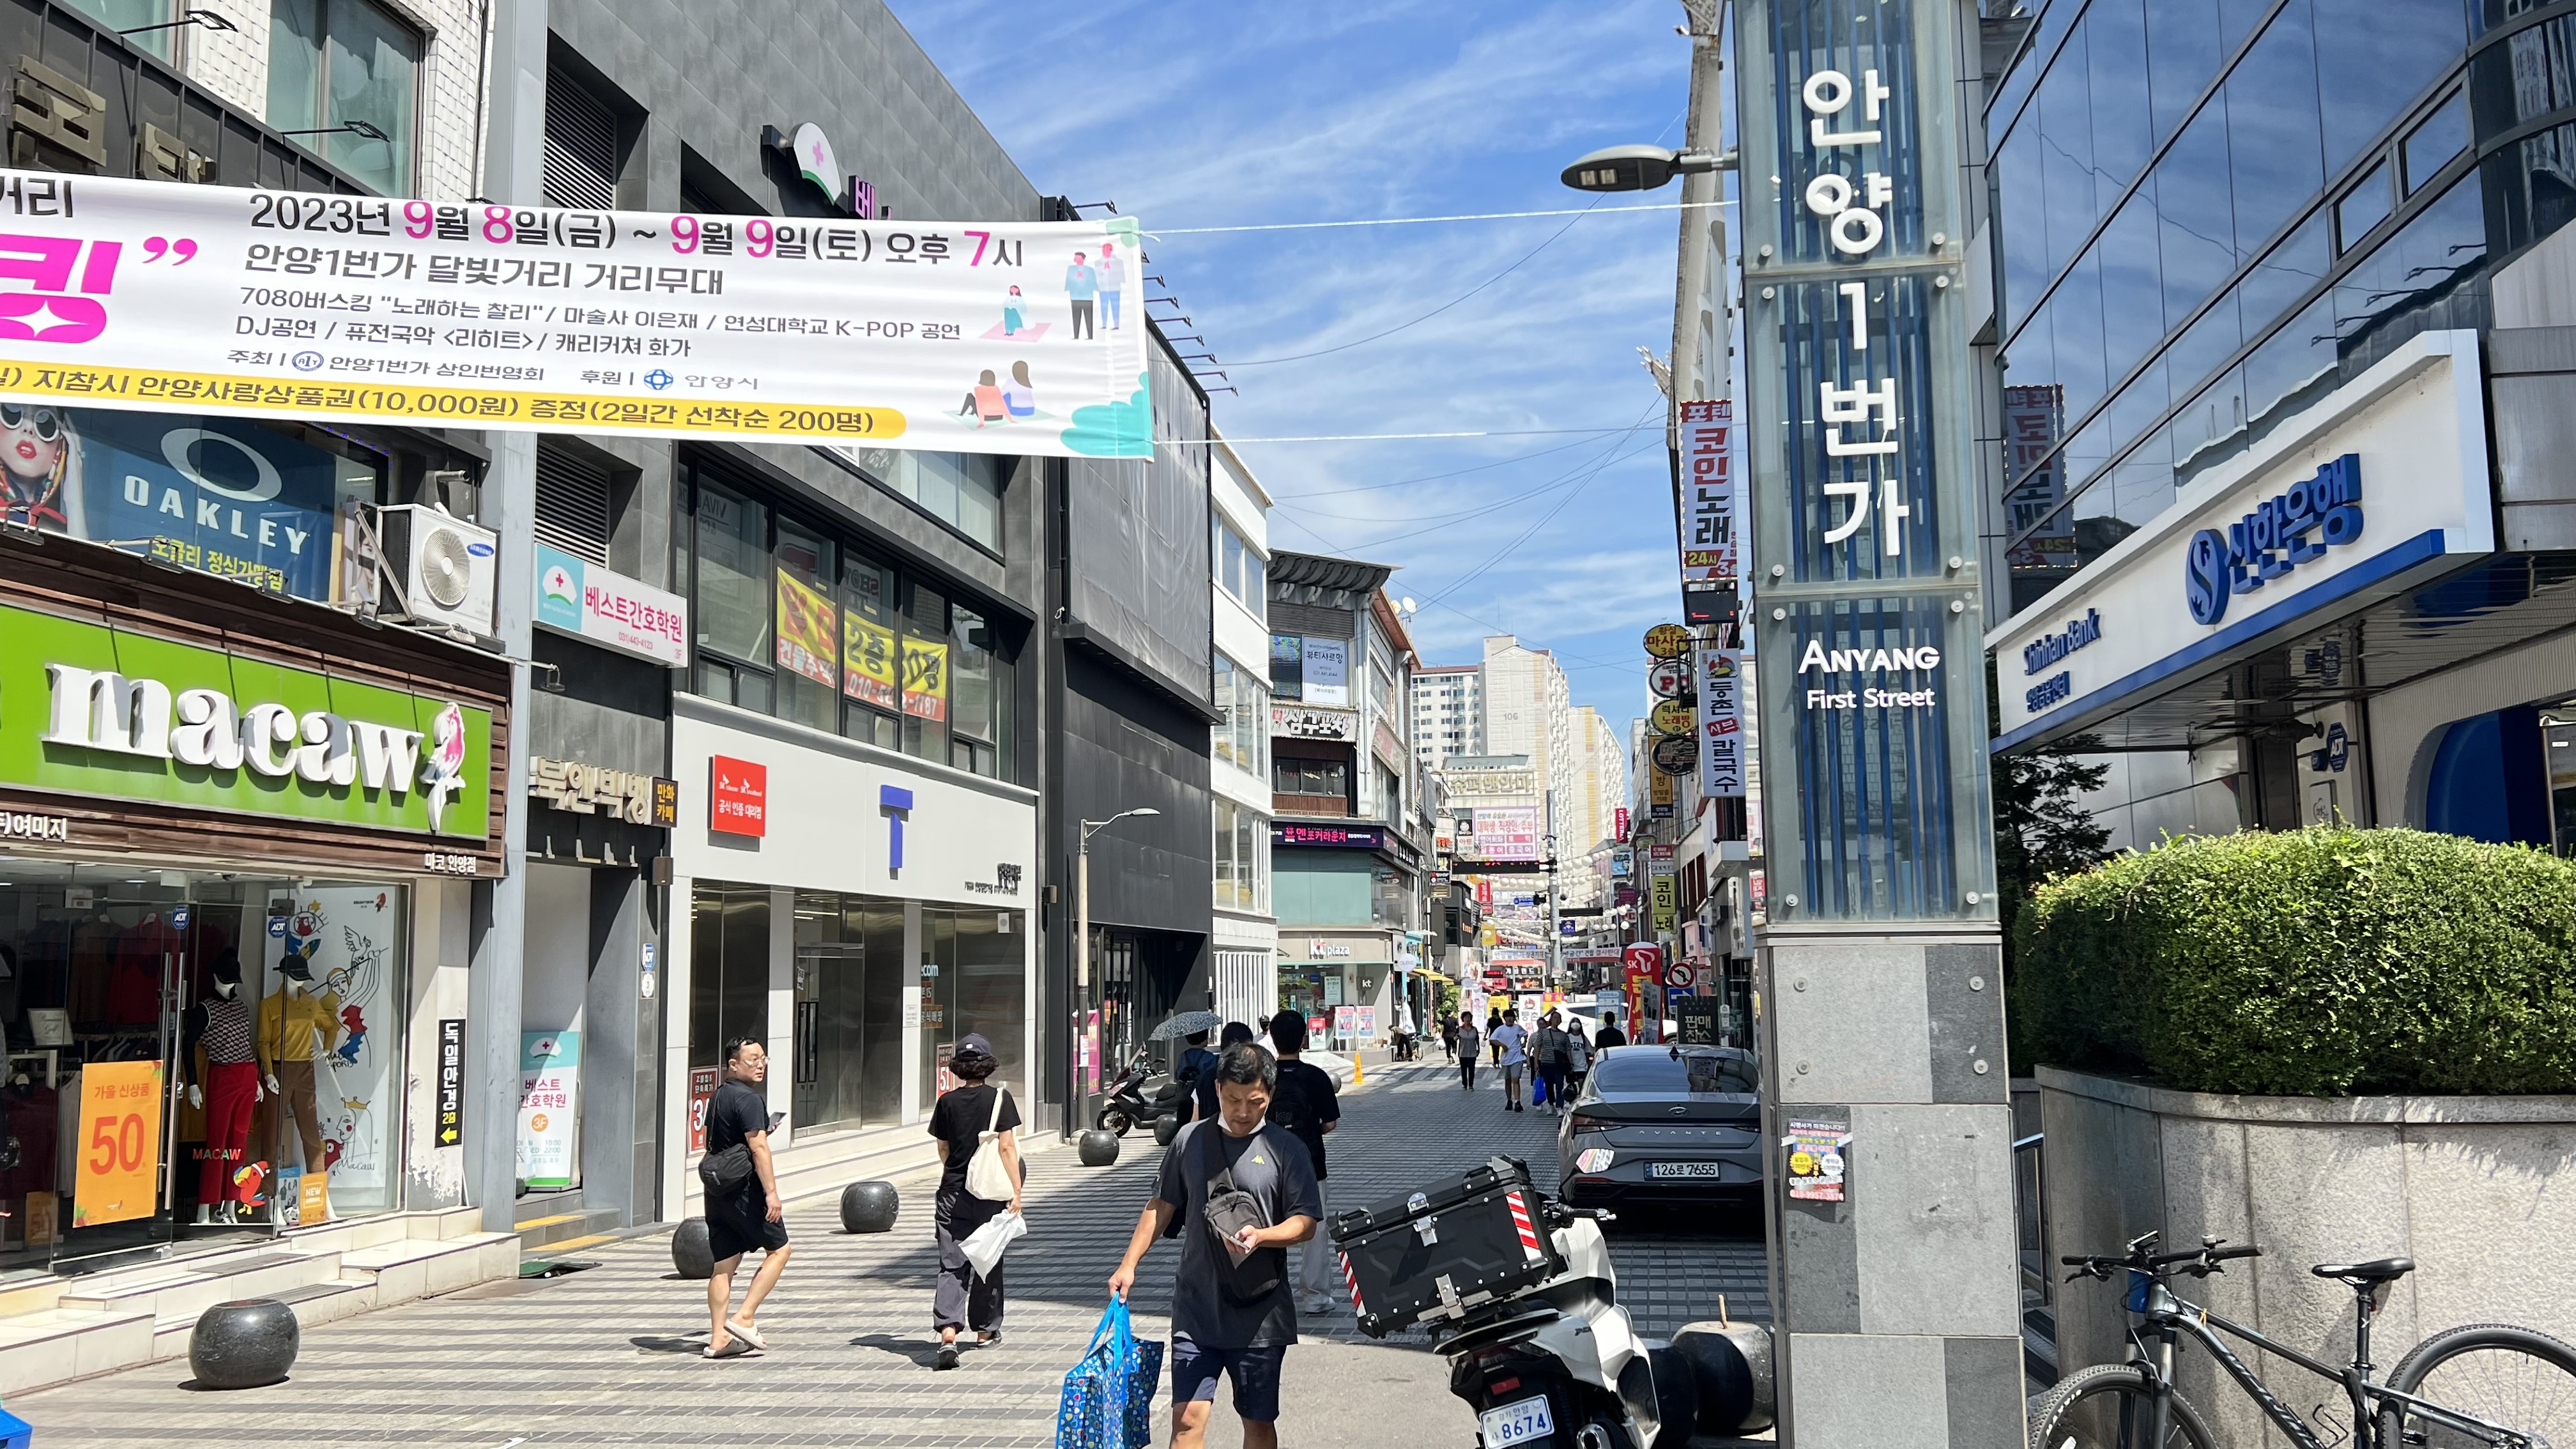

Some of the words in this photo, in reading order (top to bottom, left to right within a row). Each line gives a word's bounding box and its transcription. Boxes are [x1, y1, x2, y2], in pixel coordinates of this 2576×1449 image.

[249, 194, 391, 238] 2023년
[403, 201, 470, 242] 9월
[483, 205, 618, 251] 8일(금)
[671, 215, 734, 257] 9월
[745, 219, 871, 263] 9일(토)
[885, 232, 951, 268] 오후
[963, 231, 1023, 268] 7시
[245, 244, 417, 282] 안양1번가
[427, 254, 570, 291] 달빛거리
[584, 262, 723, 296] 거리무대
[239, 287, 372, 314] 7080버스킹
[564, 307, 628, 329] 마술사
[634, 309, 698, 331] 이은재
[724, 312, 829, 337] 연성대학교
[836, 319, 916, 339] K-POP
[921, 322, 961, 341] 공연
[1803, 69, 1910, 557] 안양1번가
[236, 316, 316, 341] DJ공연
[345, 323, 436, 346] 퓨전국악
[555, 334, 641, 358] 캐리커쳐
[648, 336, 691, 359] 화가
[227, 349, 273, 365] 주최
[329, 355, 430, 375] 안양1번가
[436, 360, 545, 382] 상인번영회
[580, 369, 622, 386] 후원
[685, 372, 758, 391] 안양시
[32, 369, 128, 394] 지참시
[138, 374, 519, 417] 안양사랑상품권(10,000원)
[530, 397, 678, 425] 증정(2일간
[686, 404, 770, 429] 선착순
[778, 409, 874, 433] 200명)
[123, 476, 310, 555] OAKLEY
[2224, 453, 2363, 594] 신한은행
[152, 535, 201, 569] 오클리
[585, 586, 682, 643] 베스트간호학원
[618, 631, 653, 650] 031)443-4123
[848, 624, 885, 675] 2층
[2024, 634, 2069, 676] Shinhan
[2067, 608, 2101, 652] Bank
[675, 648, 682, 660] 3F
[1798, 640, 1940, 673] ANYANG
[1710, 681, 1733, 716] 등촌
[1807, 689, 1857, 710] First
[1864, 687, 1936, 709] Street
[41, 663, 424, 792] macaw
[1662, 714, 1690, 728] 노래방
[1712, 739, 1738, 792] 칼국수
[657, 783, 675, 803] 만화
[1451, 774, 1531, 793] 슈퍼맨안마
[657, 804, 674, 823] 카페
[719, 799, 731, 815] 공식
[732, 802, 744, 817] 인증
[745, 804, 762, 820] 대리점
[424, 853, 445, 871] 마코
[447, 855, 476, 874] 안양점
[1656, 882, 1671, 908] 코인
[272, 923, 285, 932] ADT
[1656, 916, 1674, 931] 노래
[1310, 939, 1326, 956] kt
[1327, 944, 1350, 956] plaza
[1627, 960, 1638, 969] SK
[442, 1022, 459, 1112] 독일안경
[95, 1084, 115, 1100] 가을
[119, 1083, 150, 1098] 신상품
[525, 1078, 561, 1092] 베스트
[519, 1093, 566, 1108] 간호학원
[533, 1117, 547, 1130] 3F
[89, 1114, 145, 1176] 50
[193, 1149, 241, 1160] MACAW
[305, 1187, 321, 1197] NEW
[1501, 1413, 1546, 1439] 8674
